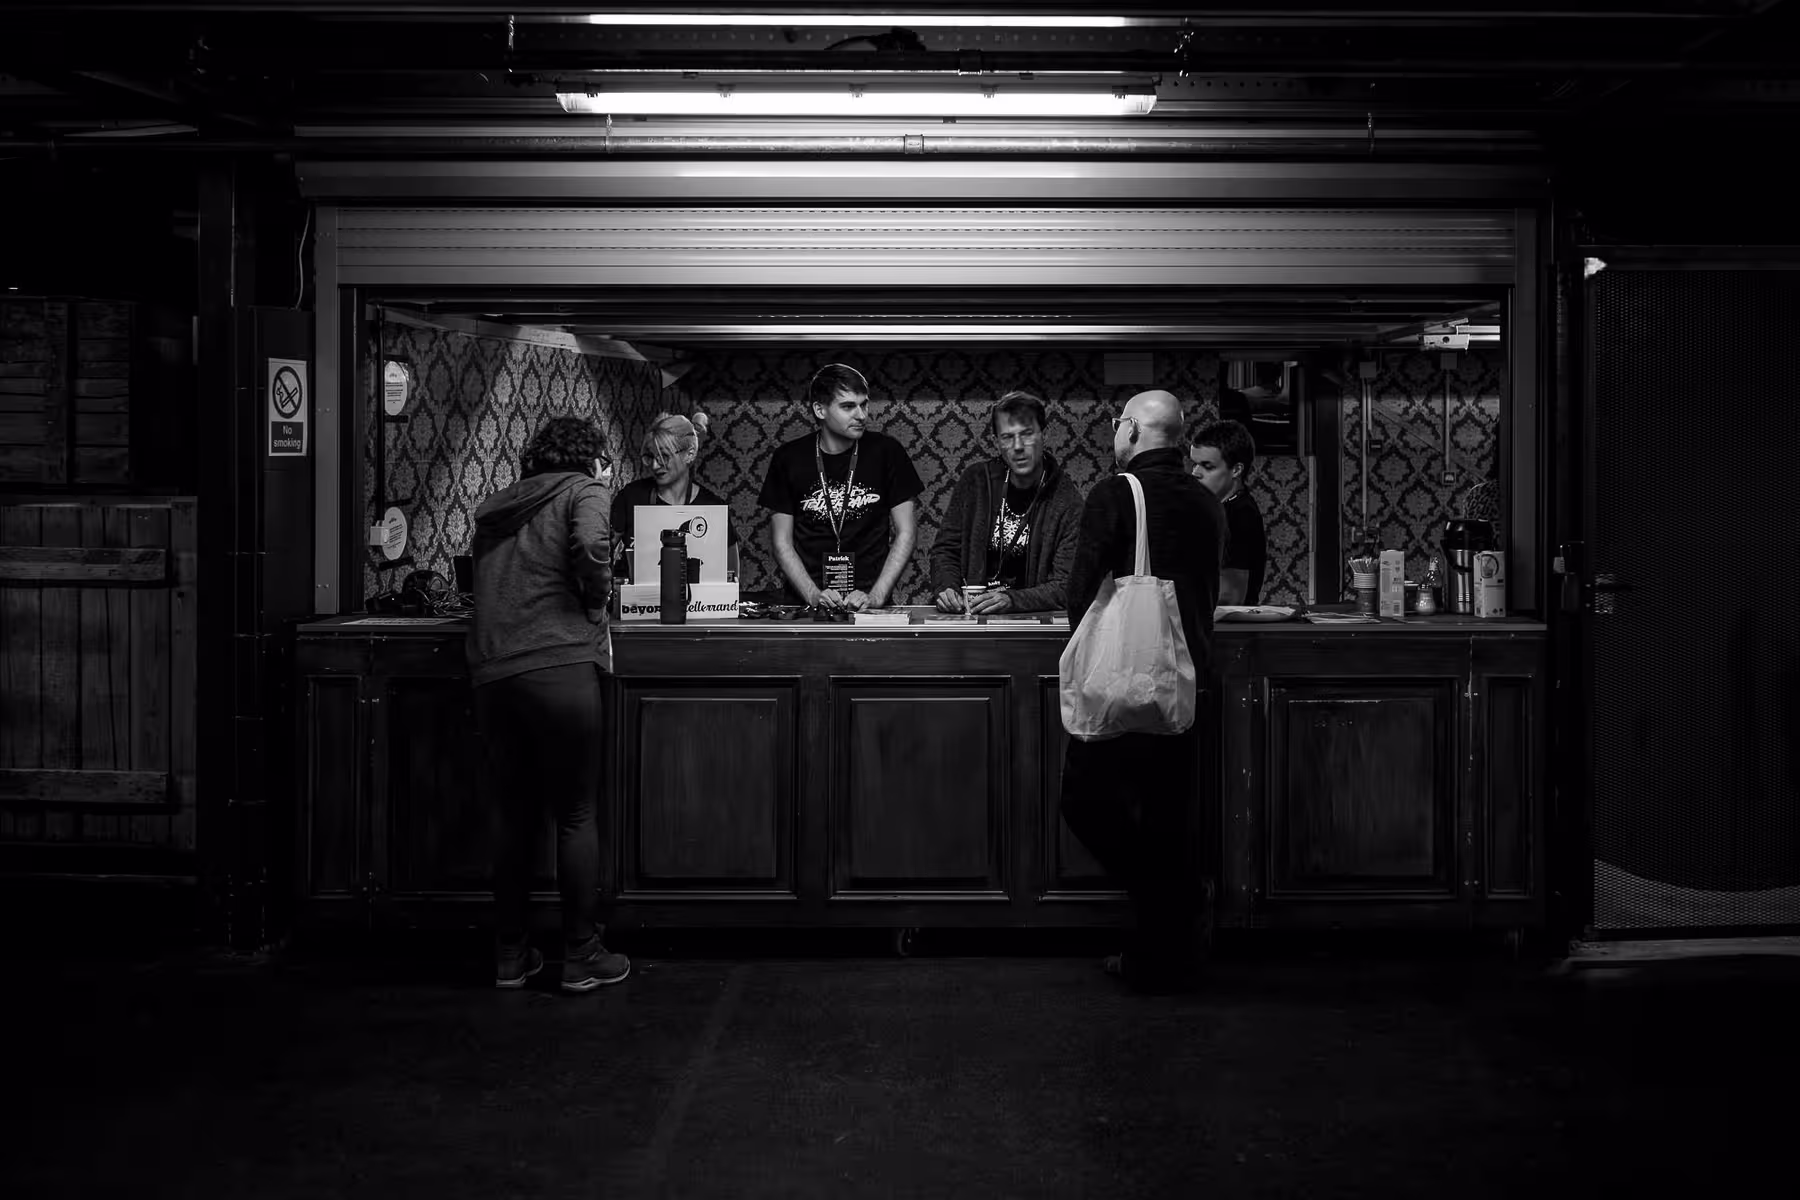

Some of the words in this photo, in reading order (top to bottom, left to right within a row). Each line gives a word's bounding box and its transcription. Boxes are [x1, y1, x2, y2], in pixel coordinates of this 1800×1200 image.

[282, 425, 293, 435] No
[273, 438, 302, 450] smoking
[622, 604, 661, 616] beyon
[686, 600, 738, 613] ellerrand
